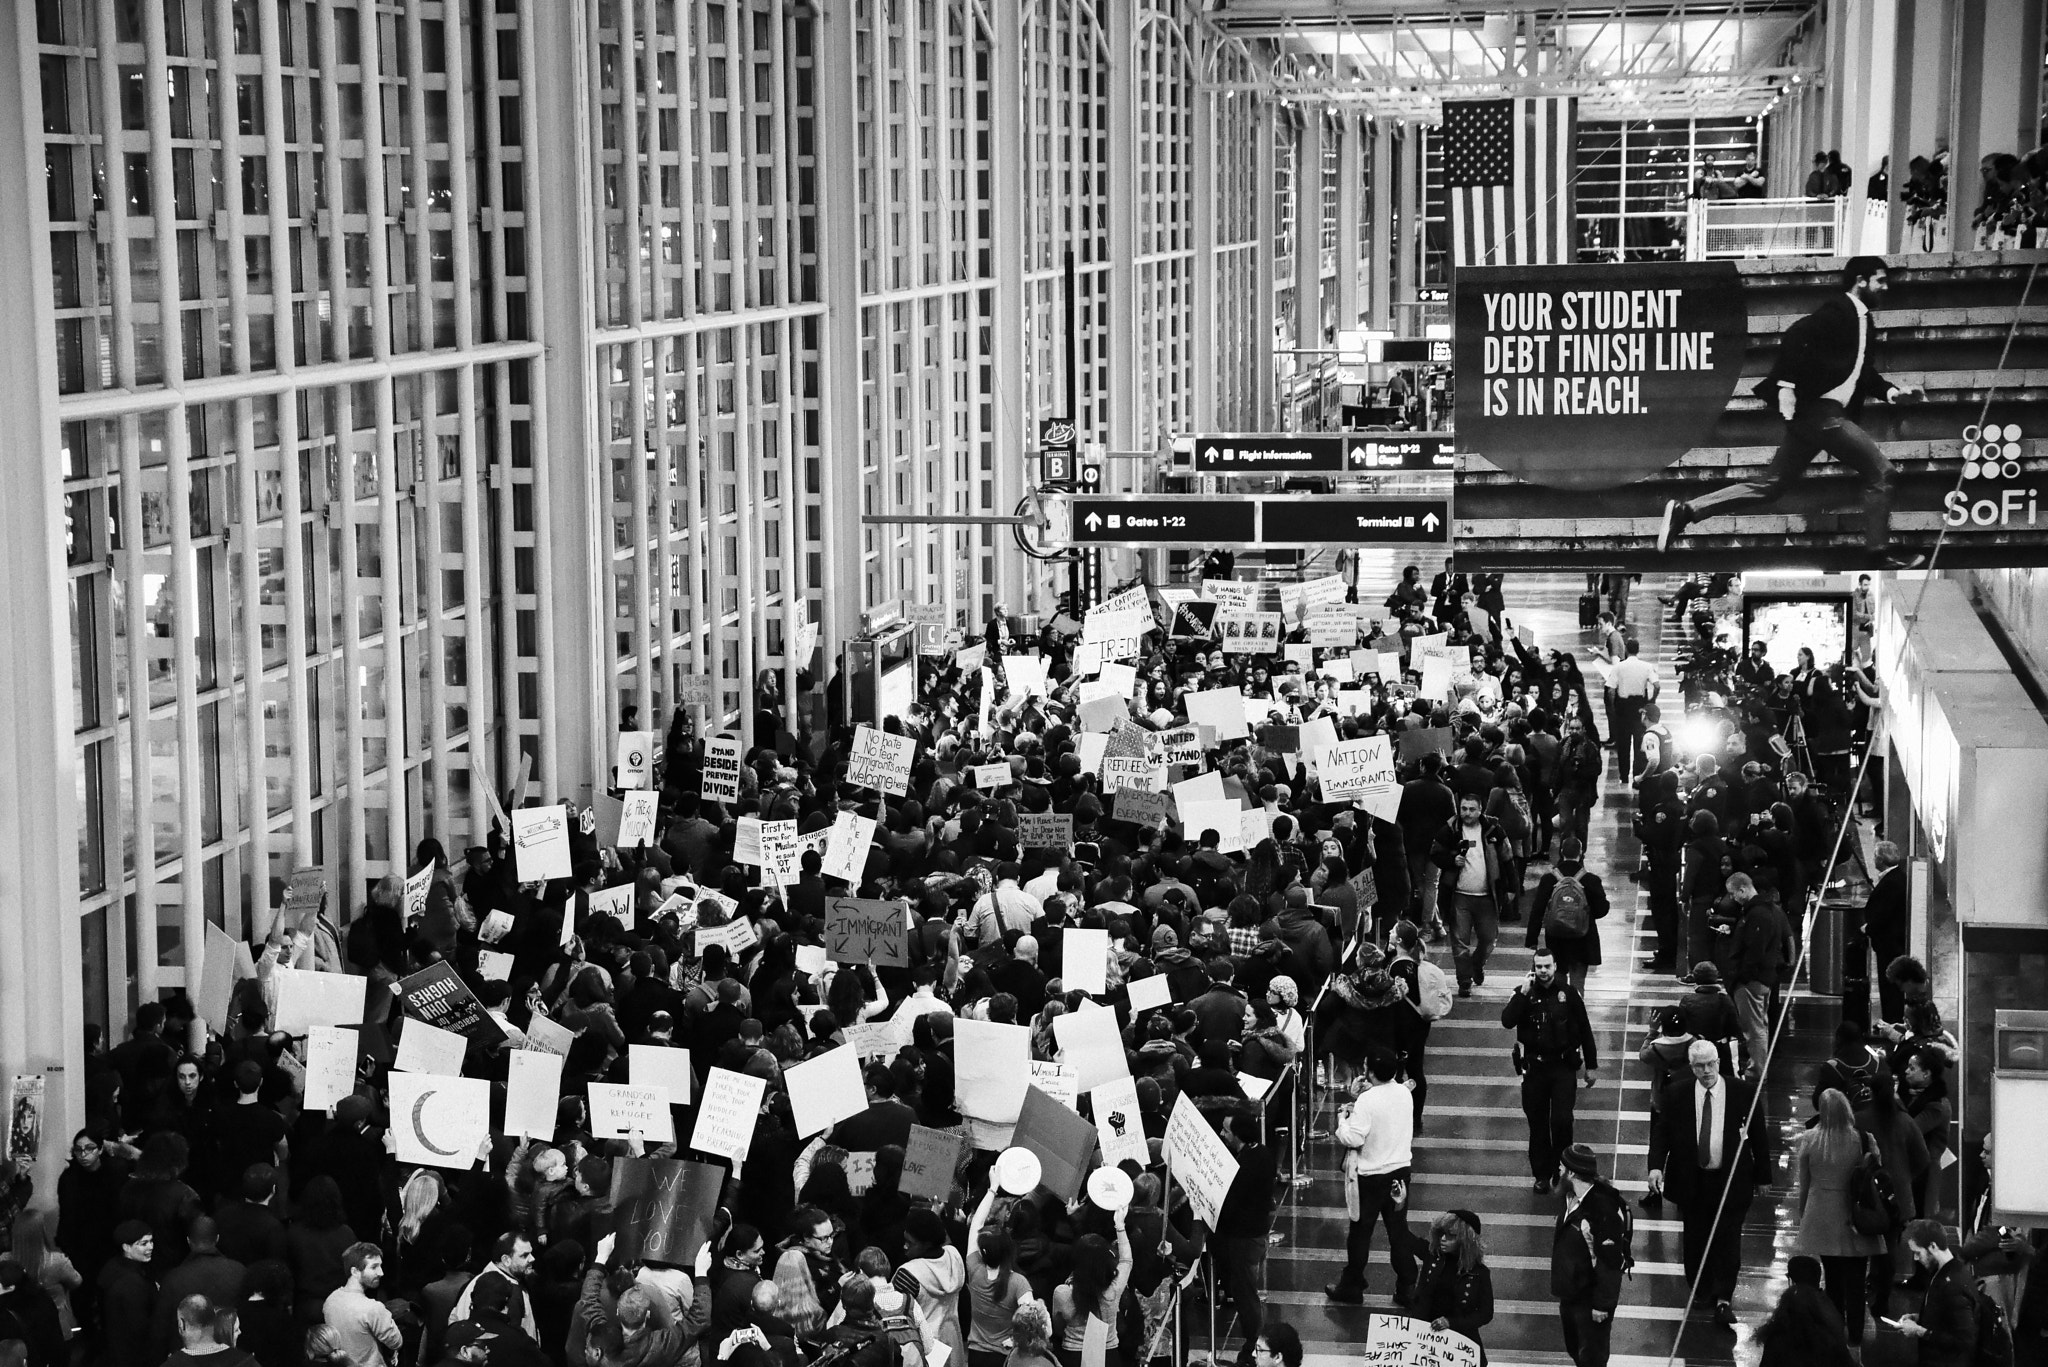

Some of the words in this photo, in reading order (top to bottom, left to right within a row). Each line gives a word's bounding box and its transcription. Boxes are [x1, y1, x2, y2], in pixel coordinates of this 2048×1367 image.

[1483, 292, 1551, 332] YOUR
[1561, 289, 1682, 330] STUDENT
[1484, 335, 1546, 375] DEBT
[1558, 333, 1646, 373] FINISH
[1656, 332, 1714, 371] LINE
[1483, 377, 1507, 417] IS
[1517, 377, 1543, 416] IN
[1554, 376, 1648, 415] REACH.
[1239, 450, 1262, 461] Flight
[1263, 450, 1312, 460] Information
[1379, 444, 1399, 454] Gates
[1400, 444, 1420, 454] 10-22
[1052, 458, 1063, 477] B
[1943, 489, 2037, 526] SoFi
[1126, 516, 1158, 527] Gates
[1163, 516, 1186, 527] 1-22
[1357, 516, 1402, 527] Terminal
[1115, 590, 1140, 607] CAPITOL
[867, 729, 879, 744] No
[882, 733, 901, 749] hate
[1162, 733, 1195, 746] UNITED
[712, 747, 735, 756] STAND
[864, 741, 877, 756] No
[1328, 744, 1381, 767] NATION
[704, 756, 738, 771] BESIDE
[850, 751, 894, 772] Immigrants
[1148, 754, 1162, 764] WE
[1167, 750, 1200, 763] STAND
[1108, 759, 1149, 774] REFUGEES
[1352, 765, 1364, 773] OF
[706, 771, 738, 782] PREVENT
[850, 763, 893, 789] Welcome
[1325, 771, 1395, 791] IMMIGRANTS
[703, 782, 735, 797] DIVIDE
[1117, 788, 1163, 806] AMERICA
[1116, 808, 1160, 822] EVERYONE
[762, 822, 781, 834] First
[783, 822, 796, 832] they
[762, 835, 779, 843] came
[780, 833, 791, 841] for
[775, 842, 798, 852] Muslims
[408, 977, 458, 1008] HUGHES
[419, 998, 452, 1020] JOHN
[609, 1088, 656, 1101] GRANDSON
[610, 1109, 652, 1120] REFUGEE
[712, 1125, 746, 1141] YEARNING
[1116, 1127, 1125, 1136] OR
[903, 1160, 926, 1176] LOVE
[652, 1168, 691, 1192] WE
[630, 1200, 688, 1224] LOVE
[640, 1229, 673, 1255] YOU
[1380, 1316, 1410, 1331] MLK
[1377, 1341, 1411, 1350] SAME
[1384, 1351, 1402, 1360] WE
[1443, 1351, 1454, 1361] ON
